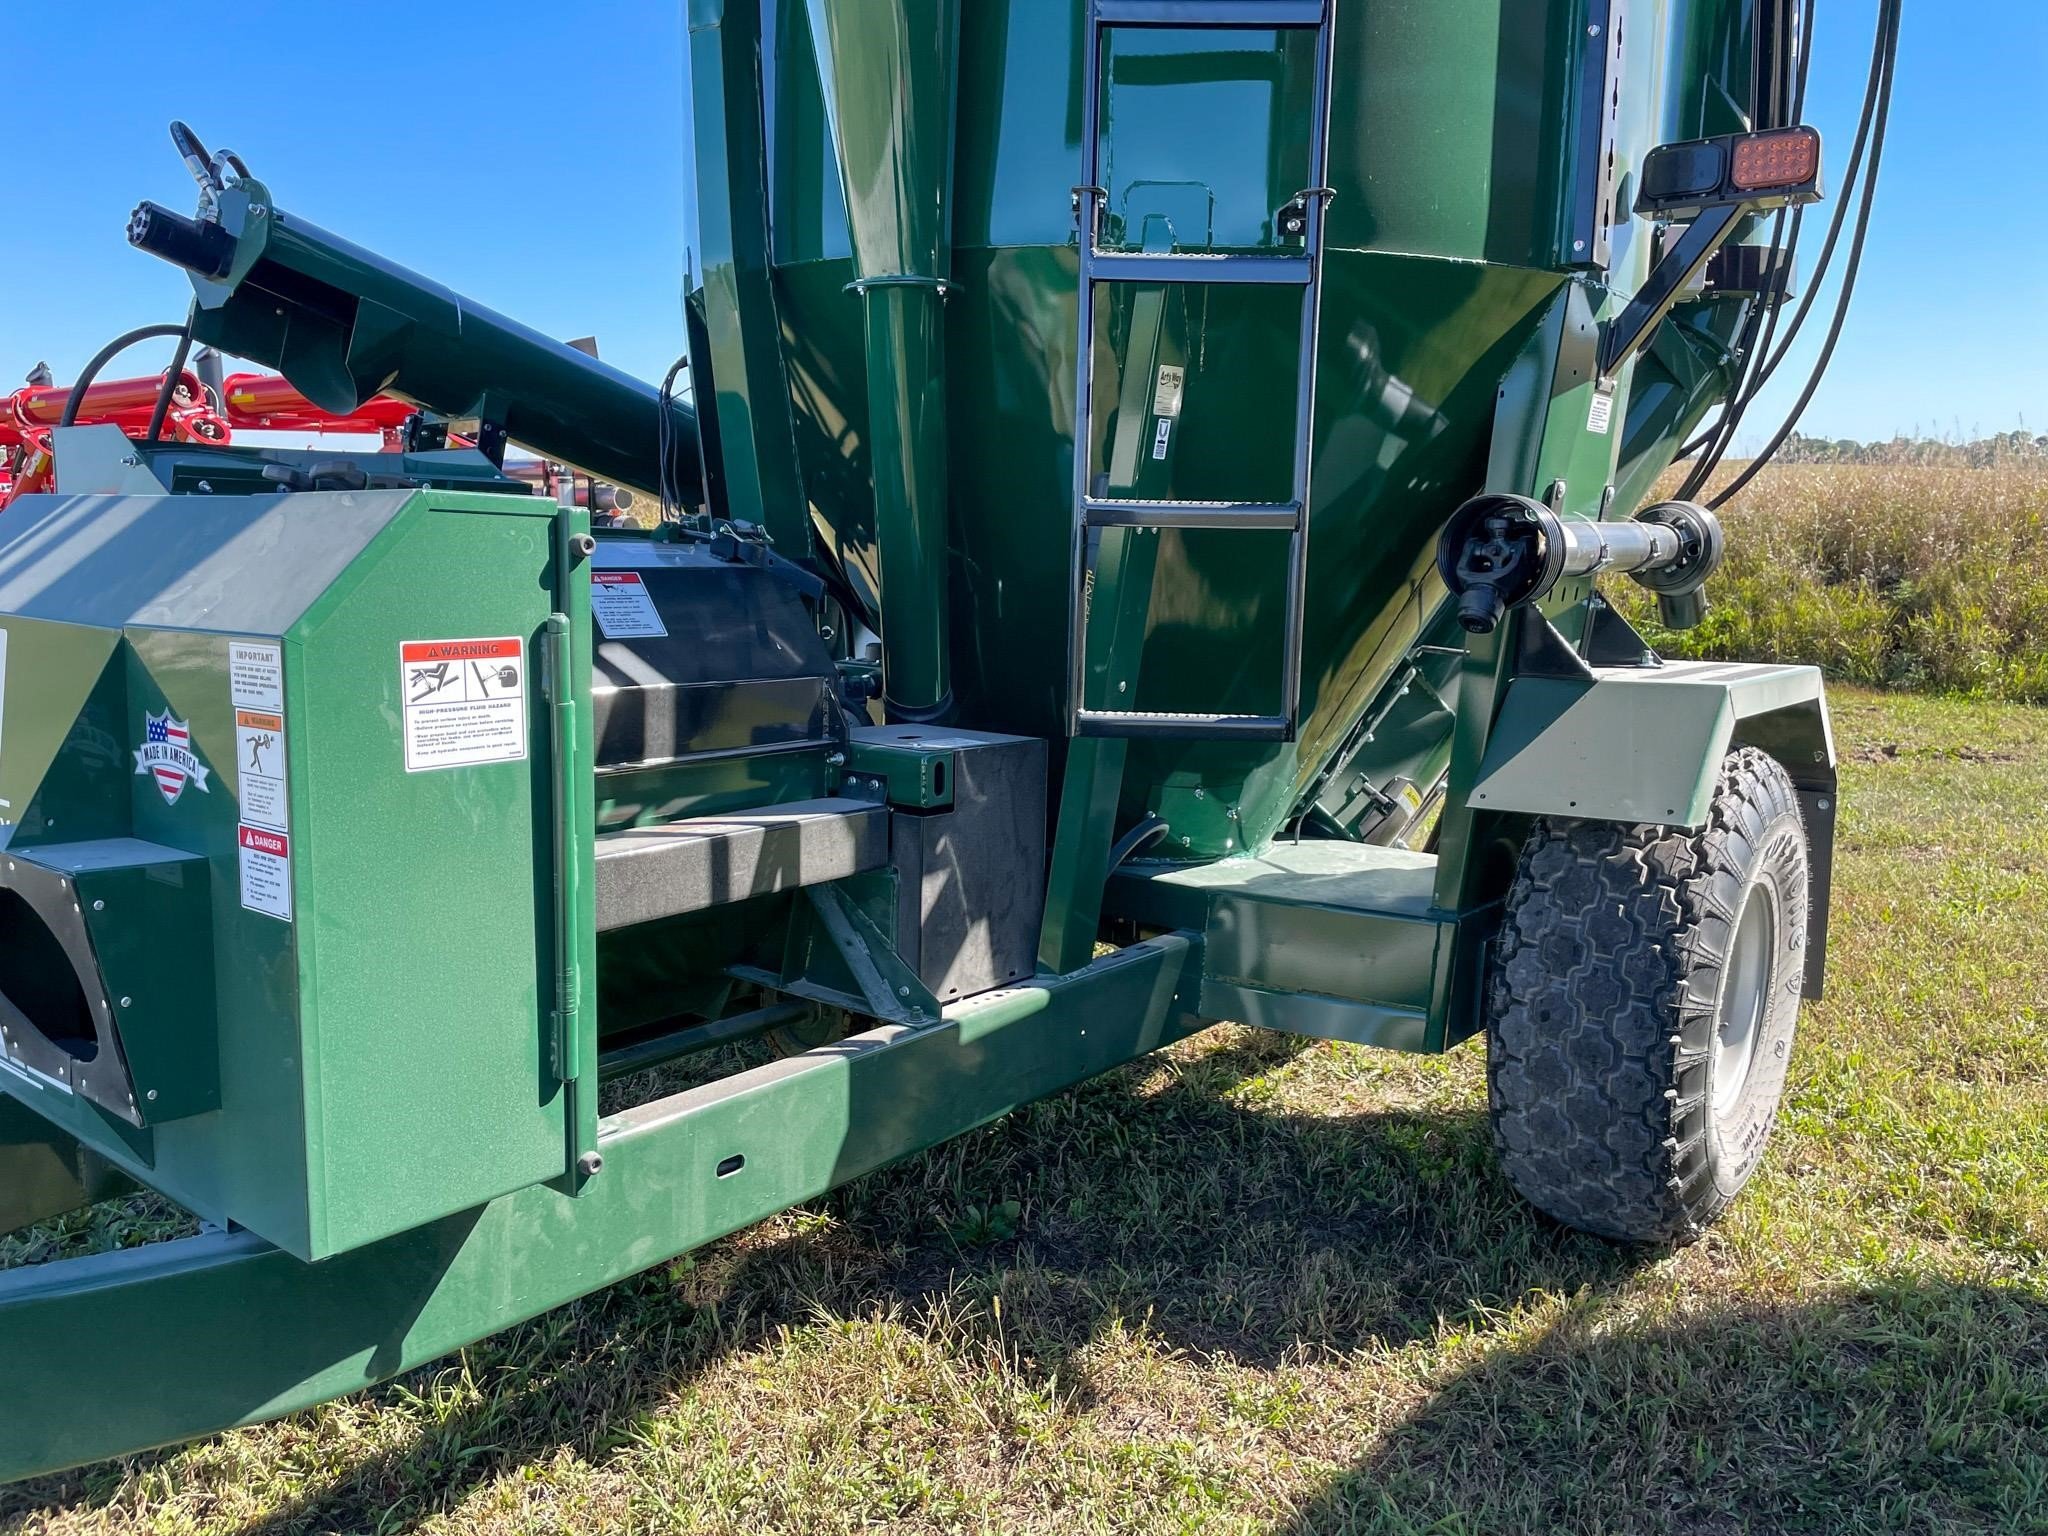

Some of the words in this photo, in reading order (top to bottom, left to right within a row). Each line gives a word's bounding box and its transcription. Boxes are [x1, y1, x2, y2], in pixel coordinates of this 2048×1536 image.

[236, 650, 273, 662] IMPORTANT
[440, 644, 499, 657] WARNING
[419, 706, 468, 715] HIGH-PRESSURE
[143, 745, 160, 761] MADE
[162, 745, 168, 759] IN
[169, 747, 196, 774] AMERICA
[254, 835, 282, 851] DANGER
